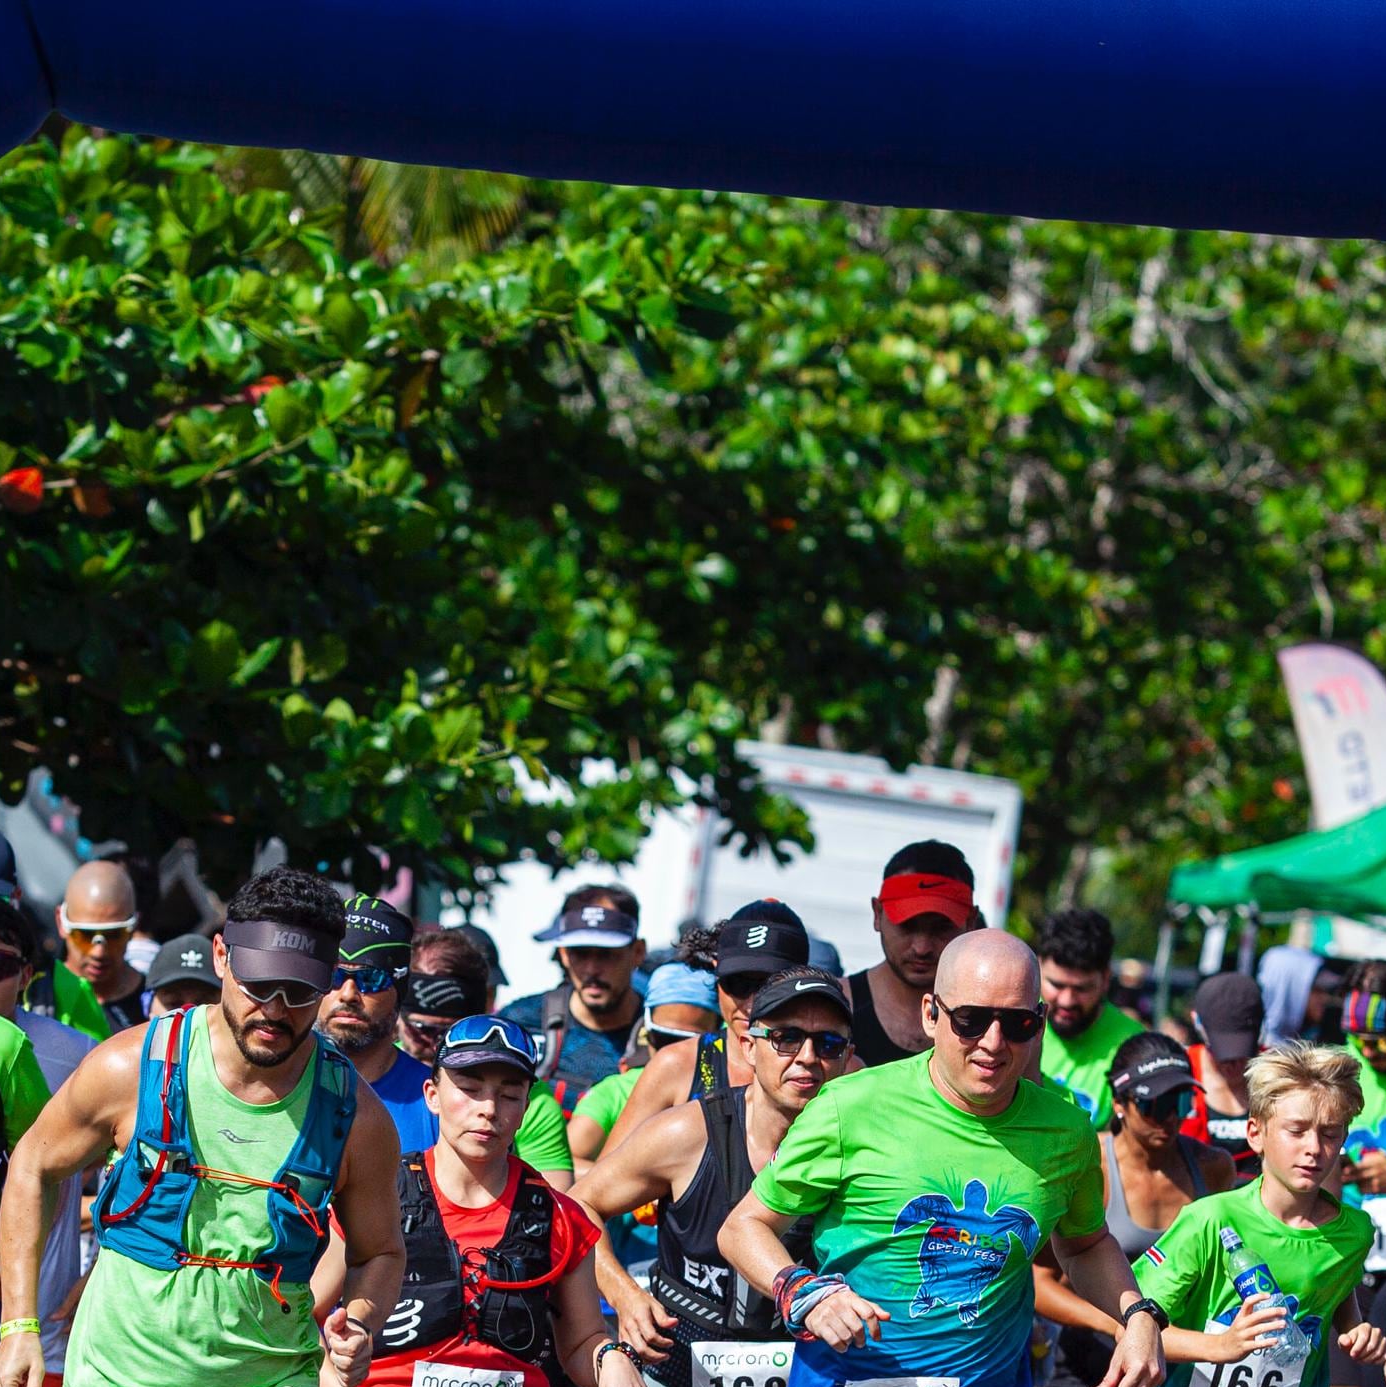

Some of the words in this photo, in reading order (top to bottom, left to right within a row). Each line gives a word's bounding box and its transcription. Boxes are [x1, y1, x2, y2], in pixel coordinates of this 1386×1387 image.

[928, 1226, 1007, 1251] CARIBE
[928, 1241, 969, 1257] GREEN
[974, 1249, 1005, 1263] FEST
